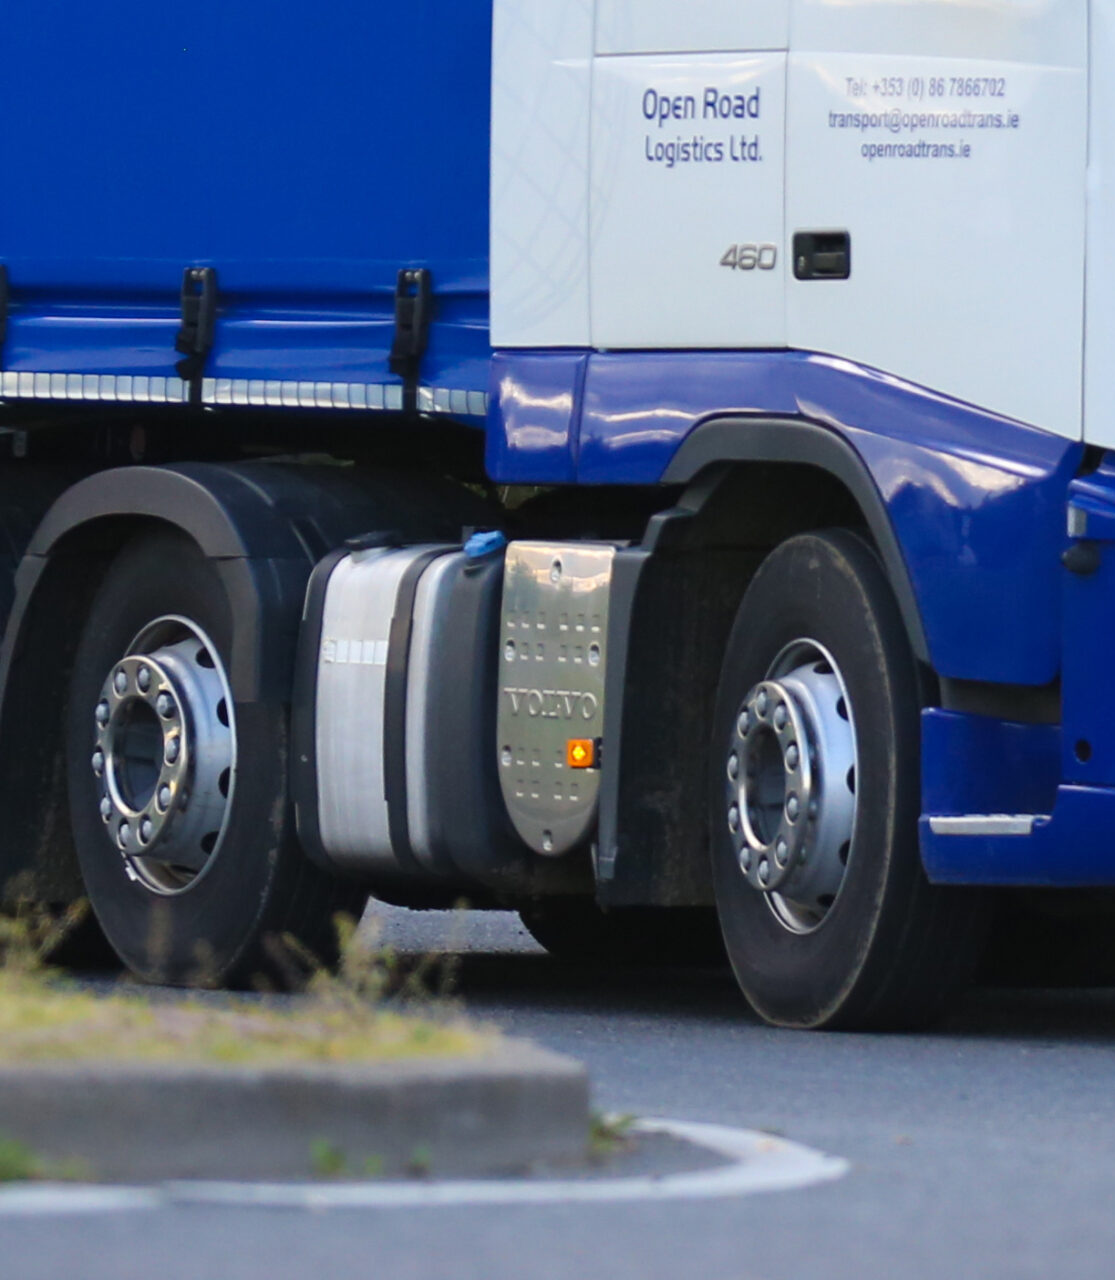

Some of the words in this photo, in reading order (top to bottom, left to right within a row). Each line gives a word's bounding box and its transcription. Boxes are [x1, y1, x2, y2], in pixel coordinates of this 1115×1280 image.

[845, 76, 868, 97] Tel:
[872, 77, 904, 97] +353
[907, 77, 926, 102] (0)
[928, 77, 945, 97] 86
[949, 78, 1006, 97] 7866702
[642, 87, 696, 126] Open
[702, 86, 760, 119] Road
[828, 107, 1020, 133] transport@openroadtrans.ie
[645, 135, 724, 168] Logistics
[729, 134, 763, 163] Ltd.
[861, 139, 972, 161] openroadtrans.ie
[719, 243, 778, 271] 460
[503, 686, 599, 719] VOLVO
